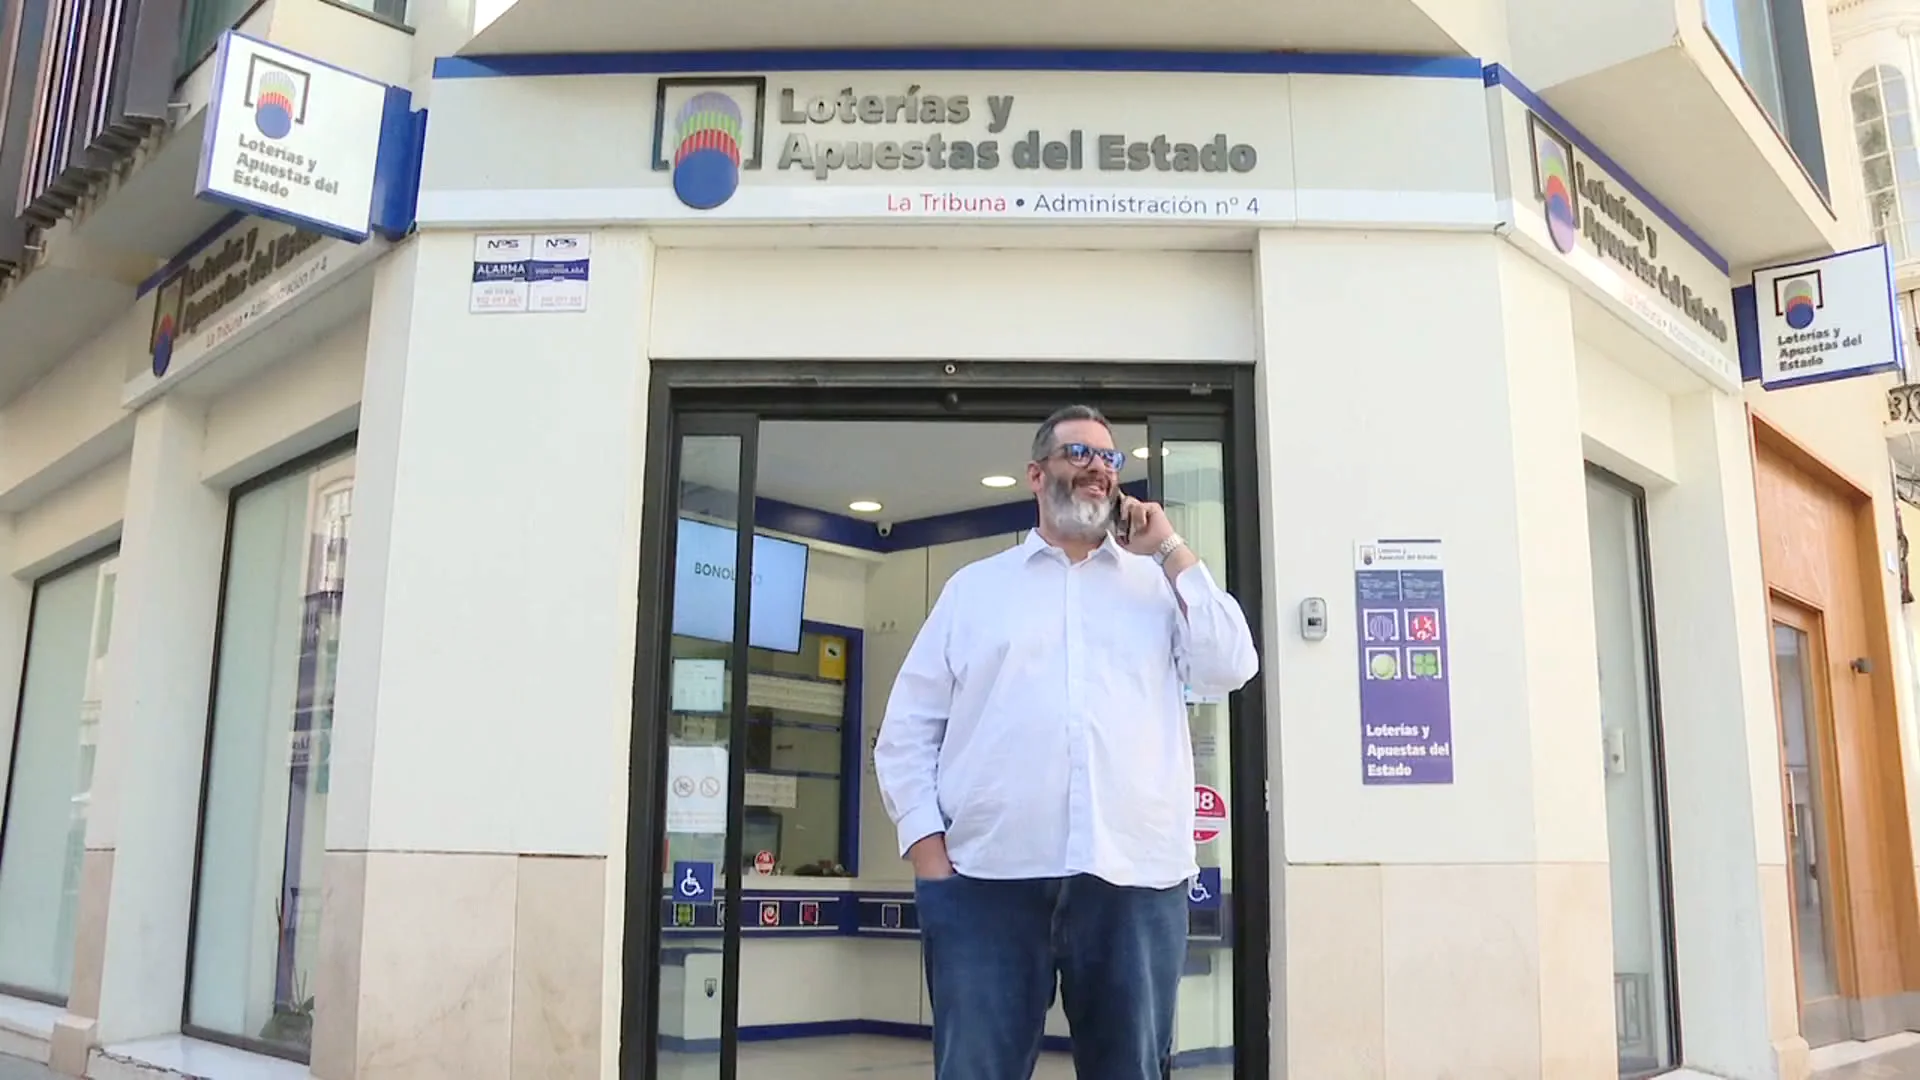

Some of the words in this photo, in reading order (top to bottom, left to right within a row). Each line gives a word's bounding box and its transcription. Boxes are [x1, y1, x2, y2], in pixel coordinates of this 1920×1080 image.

[779, 84, 971, 124] Loterías
[986, 95, 1014, 133] y
[777, 132, 1000, 181] Apuestas
[1012, 129, 1083, 170] del
[1097, 133, 1258, 173] Estado
[236, 152, 311, 186] Apuestas
[314, 176, 339, 195] del
[307, 159, 317, 173] y
[233, 169, 289, 198] Estado
[887, 193, 911, 212] La
[920, 192, 1007, 212] Tribuna
[1034, 192, 1208, 214] Administración
[1215, 197, 1240, 215] nº
[1246, 197, 1260, 215] 4
[477, 264, 526, 274] ALARMA
[1833, 327, 1841, 339] y
[1779, 341, 1838, 358] Apuestas
[1842, 333, 1863, 348] del
[1779, 355, 1824, 372] Estado
[695, 562, 763, 585] BONOLO
[1421, 725, 1430, 740] y
[1367, 743, 1426, 760] Apuestas
[1429, 741, 1450, 757] del
[1367, 762, 1412, 777] Estado
